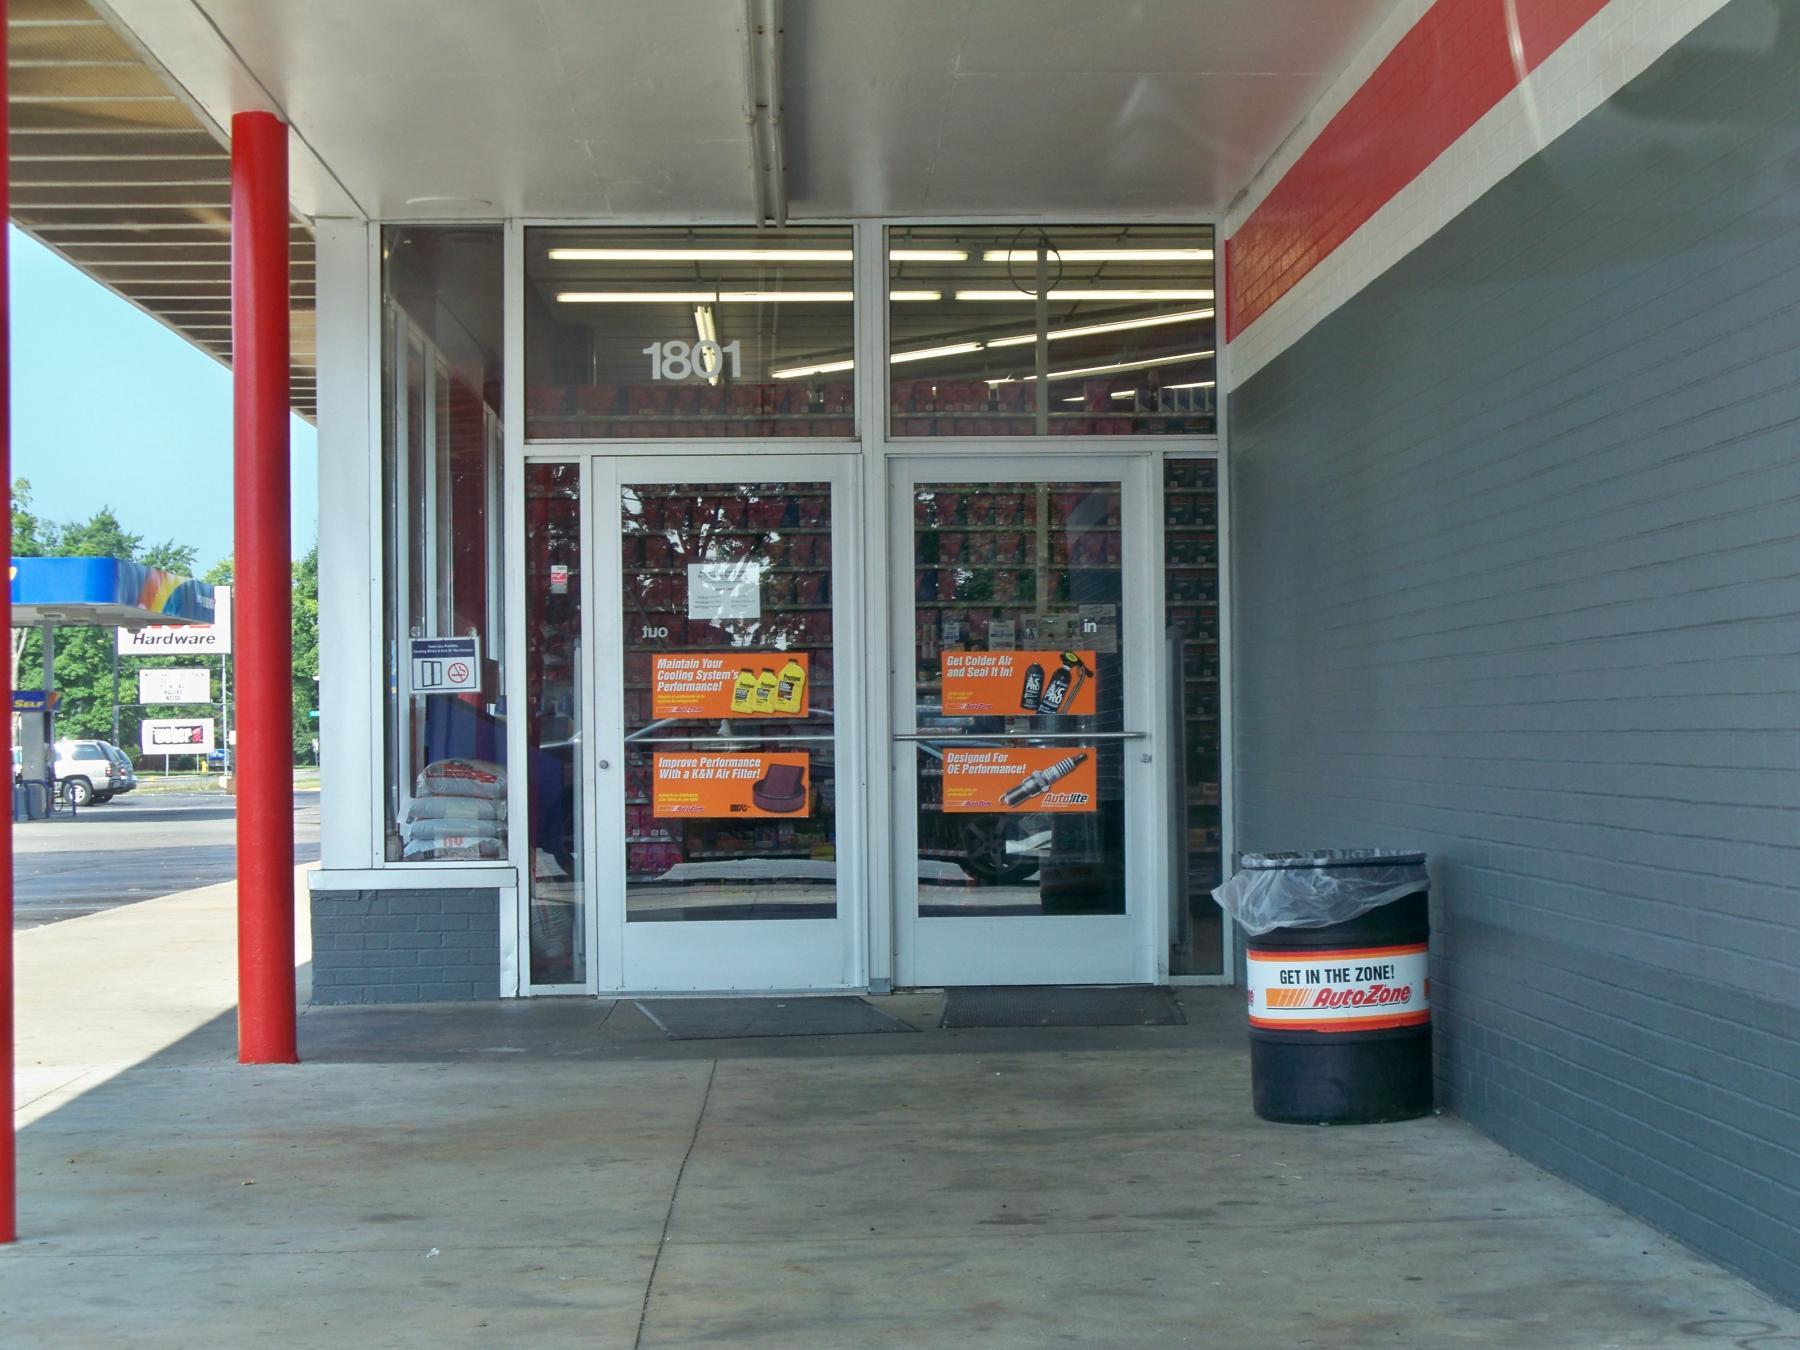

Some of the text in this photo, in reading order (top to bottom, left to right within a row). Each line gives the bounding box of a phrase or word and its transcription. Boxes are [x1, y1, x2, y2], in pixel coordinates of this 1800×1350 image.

[642, 340, 741, 380] 1801
[1083, 618, 1097, 633] in
[133, 632, 216, 645] Hardware
[657, 658, 724, 669] Maintain Your
[947, 655, 1013, 666] Get Colder Air
[657, 669, 739, 681] Cooling System's
[947, 667, 965, 677] and
[967, 667, 989, 677] Seal
[657, 681, 722, 692] Performance!
[658, 757, 761, 769] Improve Performance
[947, 752, 1009, 764] Designed For
[659, 768, 761, 779] With a K&N Air Filter!
[947, 763, 1026, 774] OE Performance!
[1043, 792, 1088, 804] Autolite
[1279, 964, 1395, 985] GET IN THE ZONE!
[1312, 983, 1412, 1009] AutoZone
